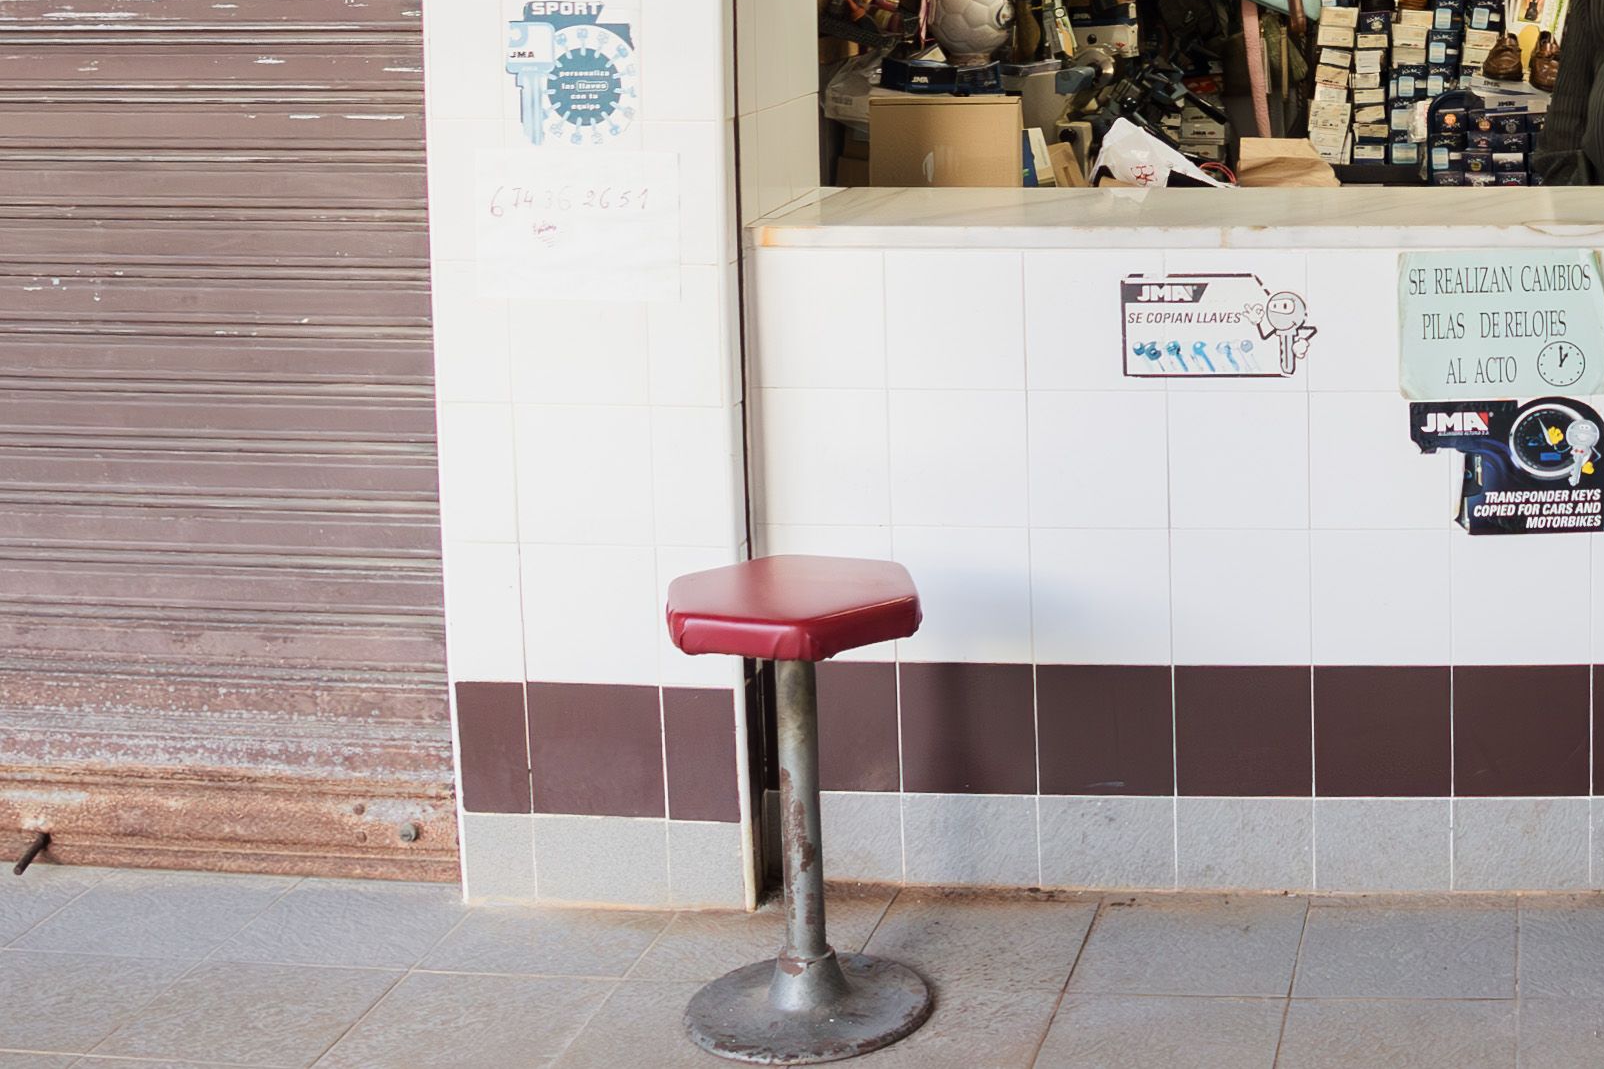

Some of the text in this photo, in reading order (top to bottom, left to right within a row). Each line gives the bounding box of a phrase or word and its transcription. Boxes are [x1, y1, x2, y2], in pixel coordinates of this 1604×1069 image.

[531, 1, 600, 16] SPORT
[1408, 263, 1592, 296] SE REALIZAN CAMBIOS
[1137, 284, 1194, 302] JMA
[1128, 313, 1242, 324] SE COPIAN LLAVES
[1422, 309, 1567, 343] PILAS DE RELOJES
[1446, 356, 1518, 385] AL ACTO
[1420, 412, 1489, 433] JMA
[1484, 489, 1602, 504] TRANSPONDER KEYS
[1473, 502, 1602, 517] COPIED FOR CARS AND
[1526, 515, 1602, 529] MOTORBIKES
